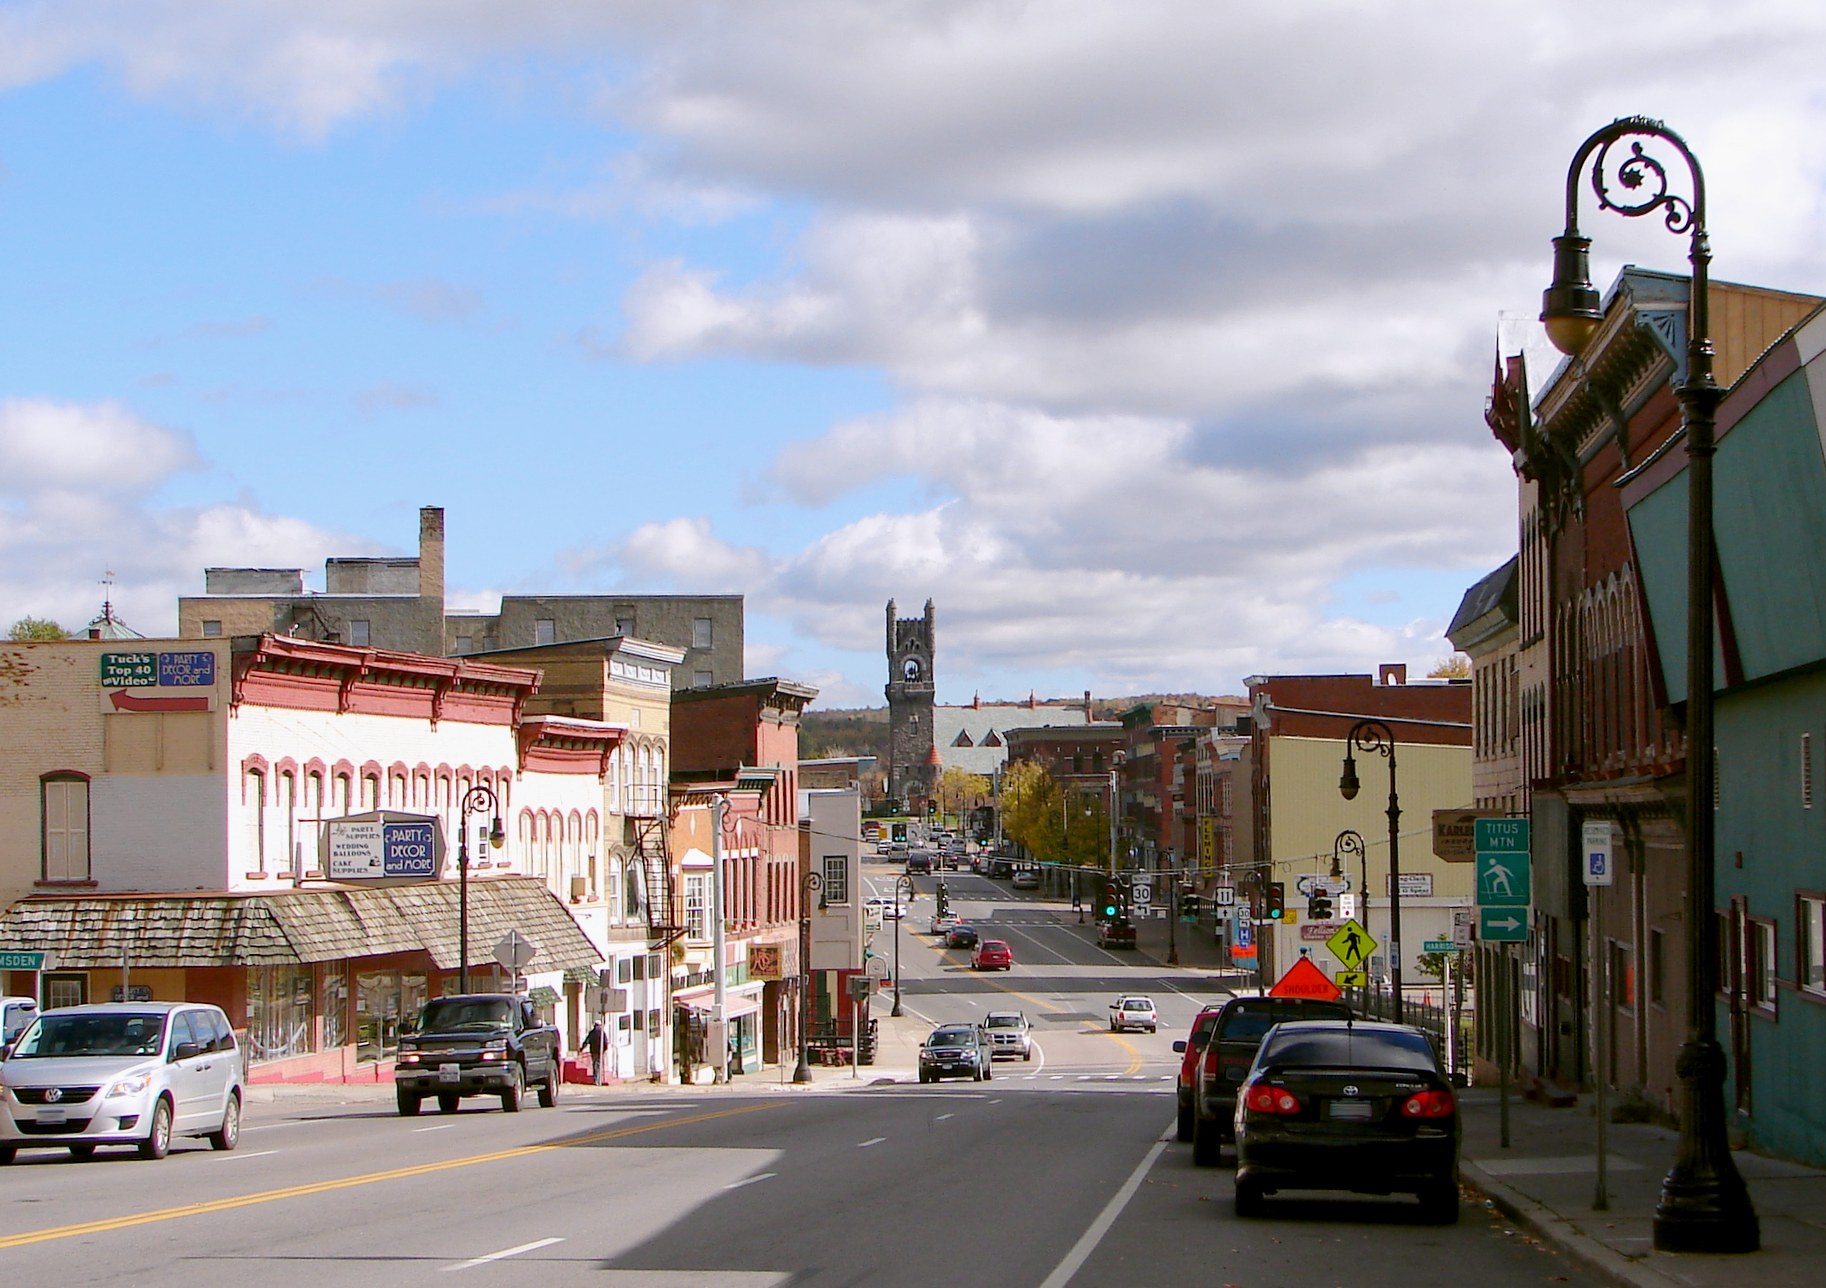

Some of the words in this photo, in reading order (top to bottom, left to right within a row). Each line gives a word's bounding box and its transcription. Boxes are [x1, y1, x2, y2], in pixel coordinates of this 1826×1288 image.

[109, 654, 150, 664] Tuck's
[174, 654, 199, 664] PARTY
[107, 665, 131, 676] Top
[135, 665, 151, 675] 40
[162, 664, 192, 675] DECOR
[193, 664, 210, 674] and
[112, 676, 148, 686] Video
[173, 675, 201, 685] MORE
[1487, 823, 1518, 834] TITUS
[392, 829, 423, 841] PARTY
[1490, 837, 1515, 847] MTN
[391, 844, 426, 858] DECOR
[386, 860, 403, 871] and
[404, 859, 432, 870] MORE
[1134, 888, 1150, 900] 30
[1220, 891, 1231, 902] 11
[1239, 909, 1250, 917] 30
[1240, 929, 1249, 939] H
